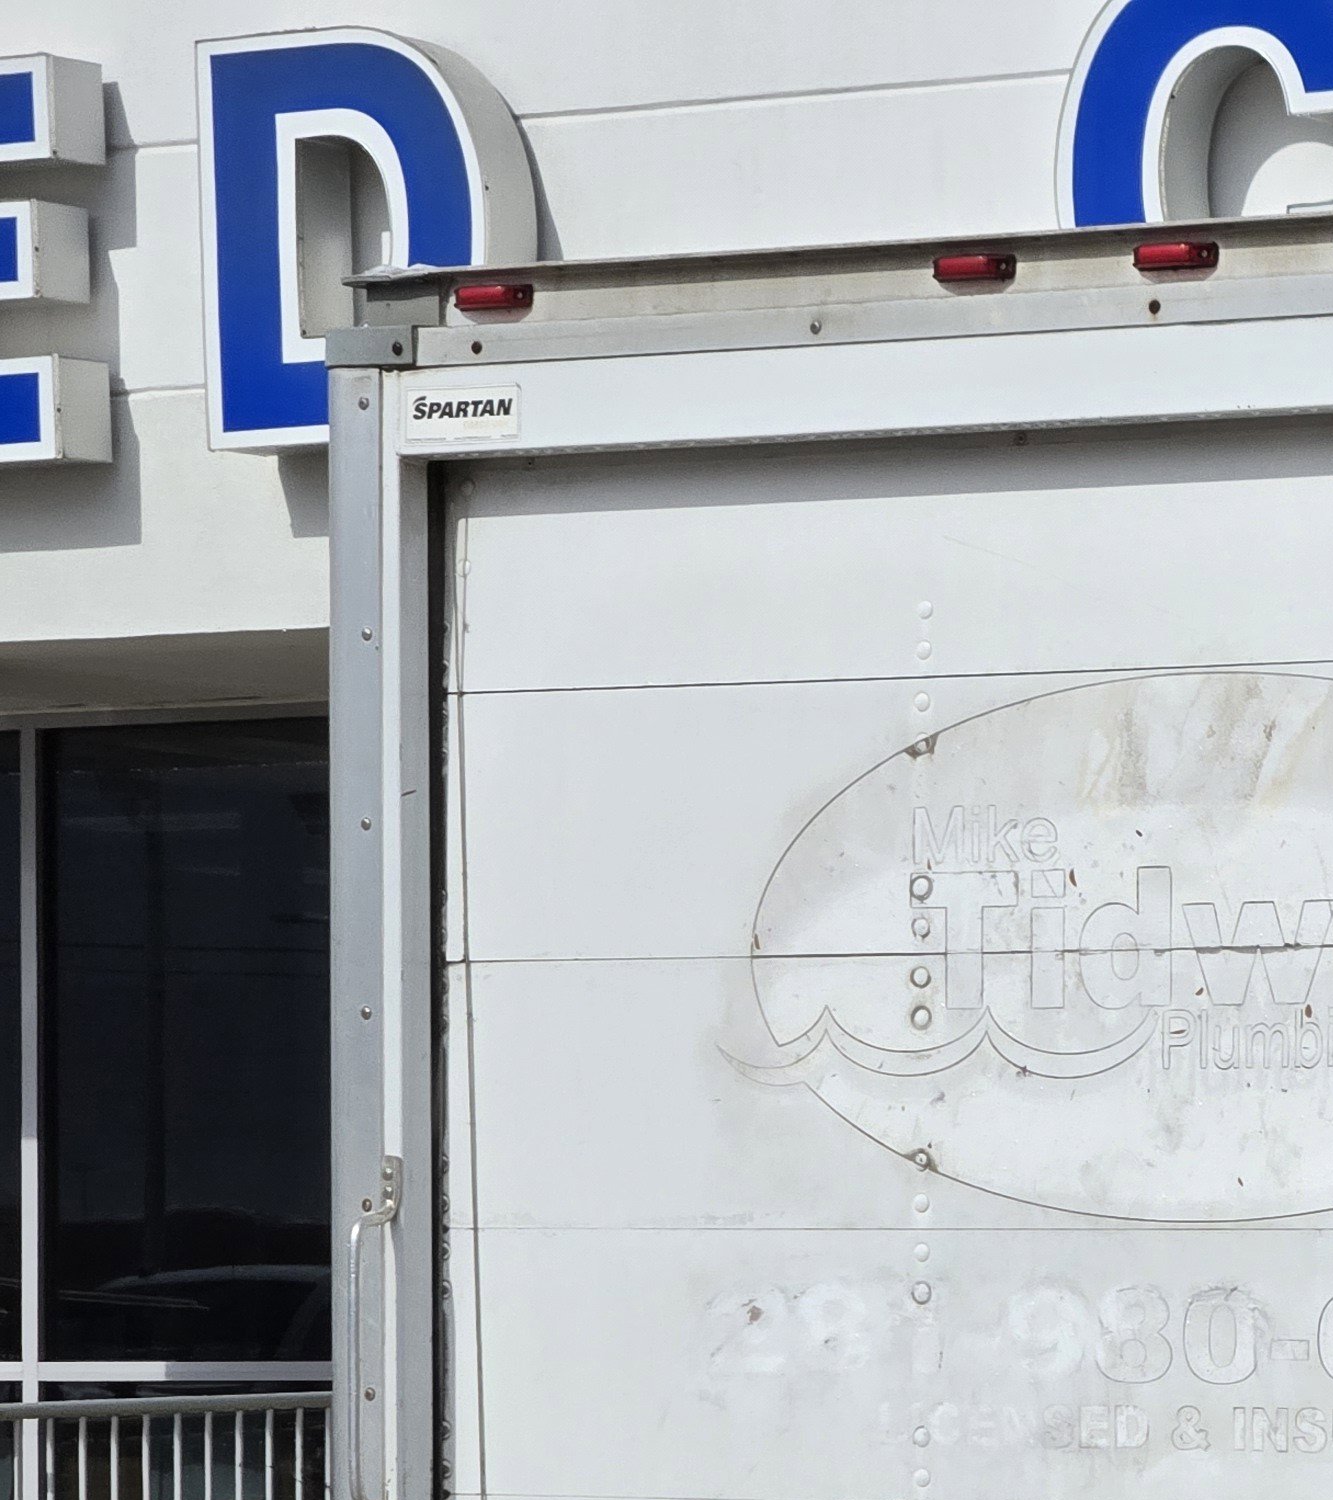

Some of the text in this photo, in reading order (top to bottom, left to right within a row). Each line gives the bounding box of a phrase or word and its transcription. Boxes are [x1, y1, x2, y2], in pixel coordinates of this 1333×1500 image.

[0, 26, 537, 462] D
[412, 395, 513, 421] SPARTAN
[911, 805, 1058, 865] Mike
[1171, 1403, 1212, 1451] &
